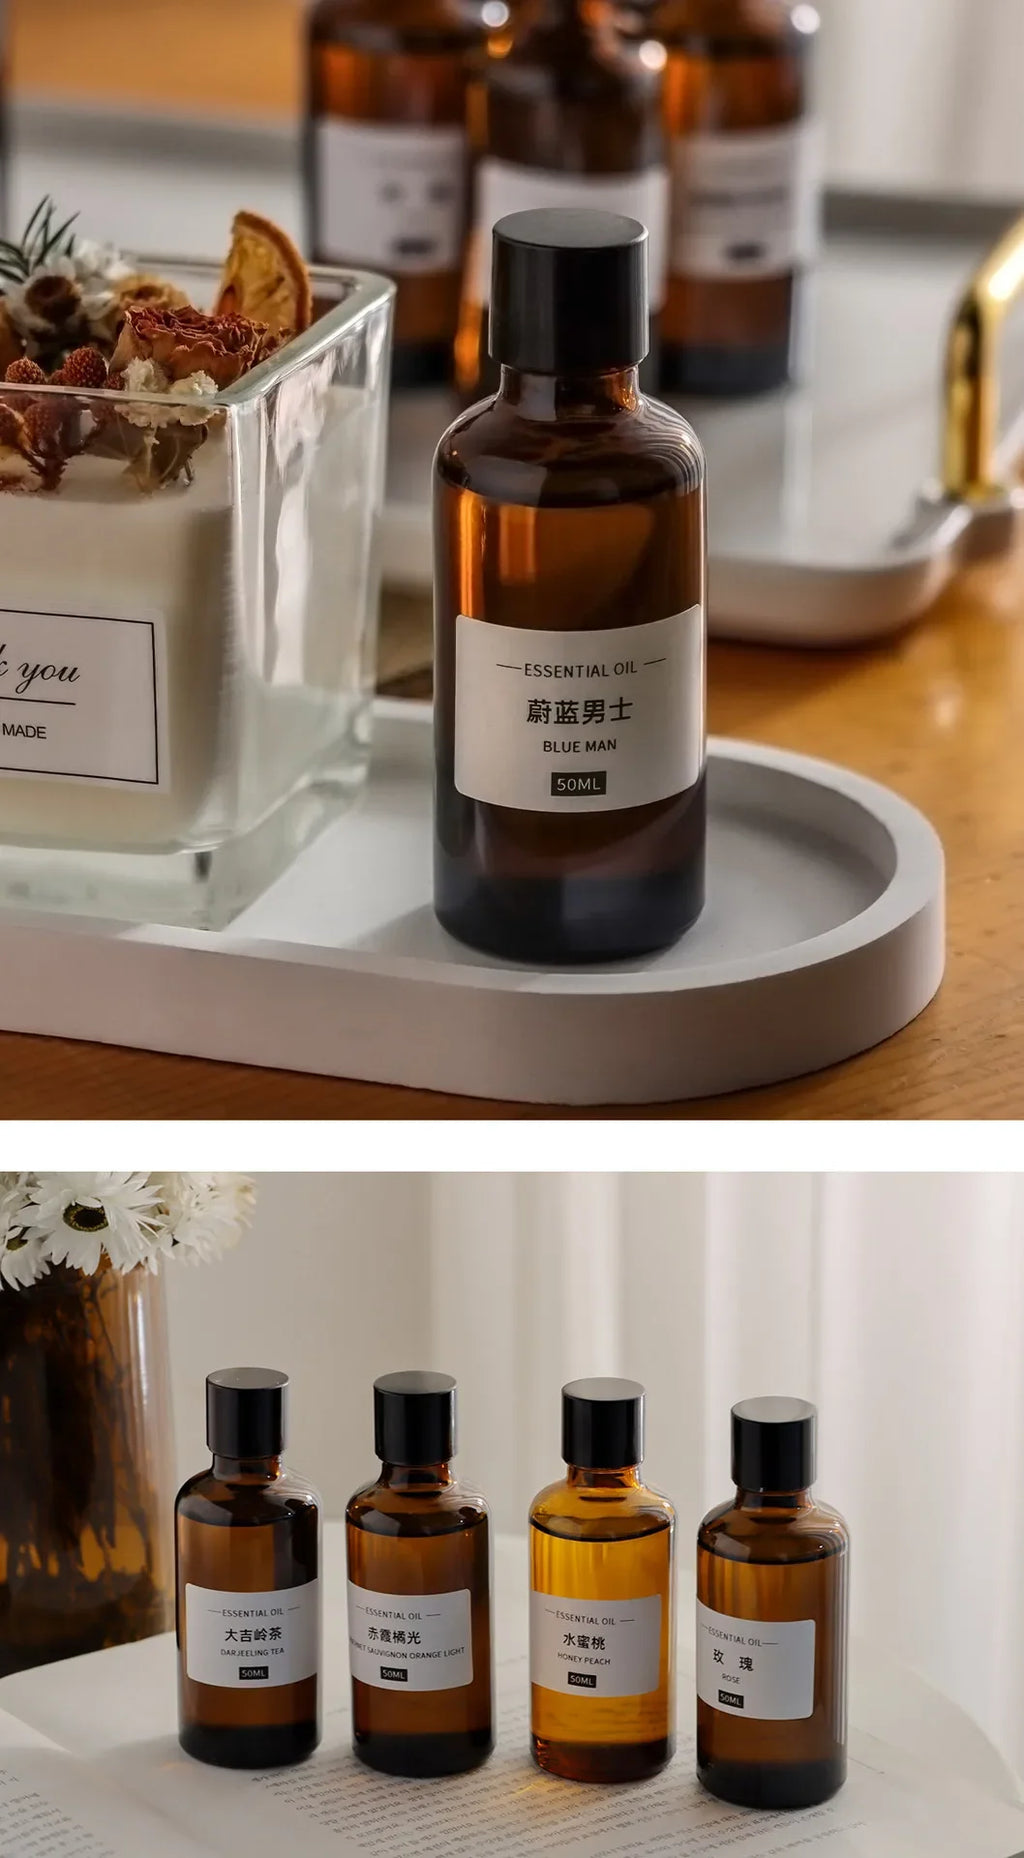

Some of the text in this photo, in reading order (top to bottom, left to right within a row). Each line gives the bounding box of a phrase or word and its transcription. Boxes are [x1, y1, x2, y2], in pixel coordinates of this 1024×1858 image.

[524, 660, 638, 679] ESSENTIAL OIL
[15, 661, 81, 695] you
[526, 696, 634, 726] 蔚蓝男士
[2, 722, 48, 740] MADE
[543, 738, 617, 753] BLUE MAN
[556, 776, 601, 792] 50ML
[222, 1607, 284, 1618] ESSENTIAL OIL
[365, 1606, 423, 1621] ESSENTIAL OIL
[556, 1610, 616, 1626] ESSENTIAL OIL
[224, 1626, 283, 1643] 大吉岭茶
[563, 1632, 606, 1651] 水蜜桃
[708, 1625, 762, 1647] ESSENTIAL OIL
[220, 1647, 285, 1657] DARJEELING TEA
[409, 1651, 442, 1660] ORANGE
[443, 1646, 465, 1658] LIGHT
[557, 1652, 612, 1666] HONEY PEACH
[241, 1669, 266, 1678] 50ML
[382, 1669, 405, 1680] 50ML
[570, 1675, 594, 1686] 50ML
[721, 1673, 741, 1685] ROSE
[719, 1692, 742, 1706] 50ML
